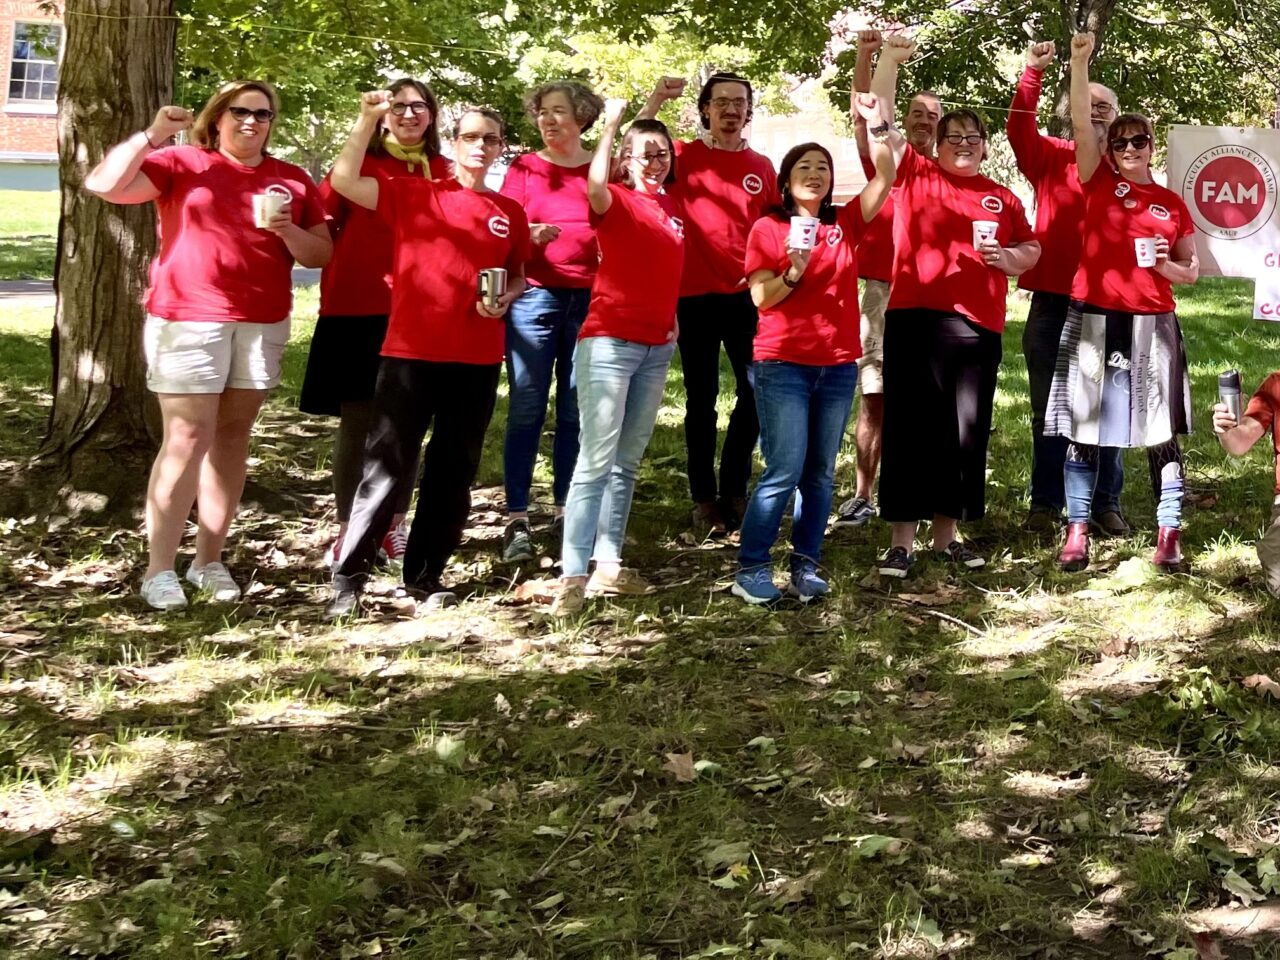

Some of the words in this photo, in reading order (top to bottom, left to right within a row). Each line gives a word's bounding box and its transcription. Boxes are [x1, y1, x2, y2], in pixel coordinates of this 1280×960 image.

[1186, 155, 1209, 190] FACULTY
[1211, 147, 1252, 158] ALLIANCE
[1262, 166, 1275, 194] MIAMI
[1201, 181, 1258, 205] FAM
